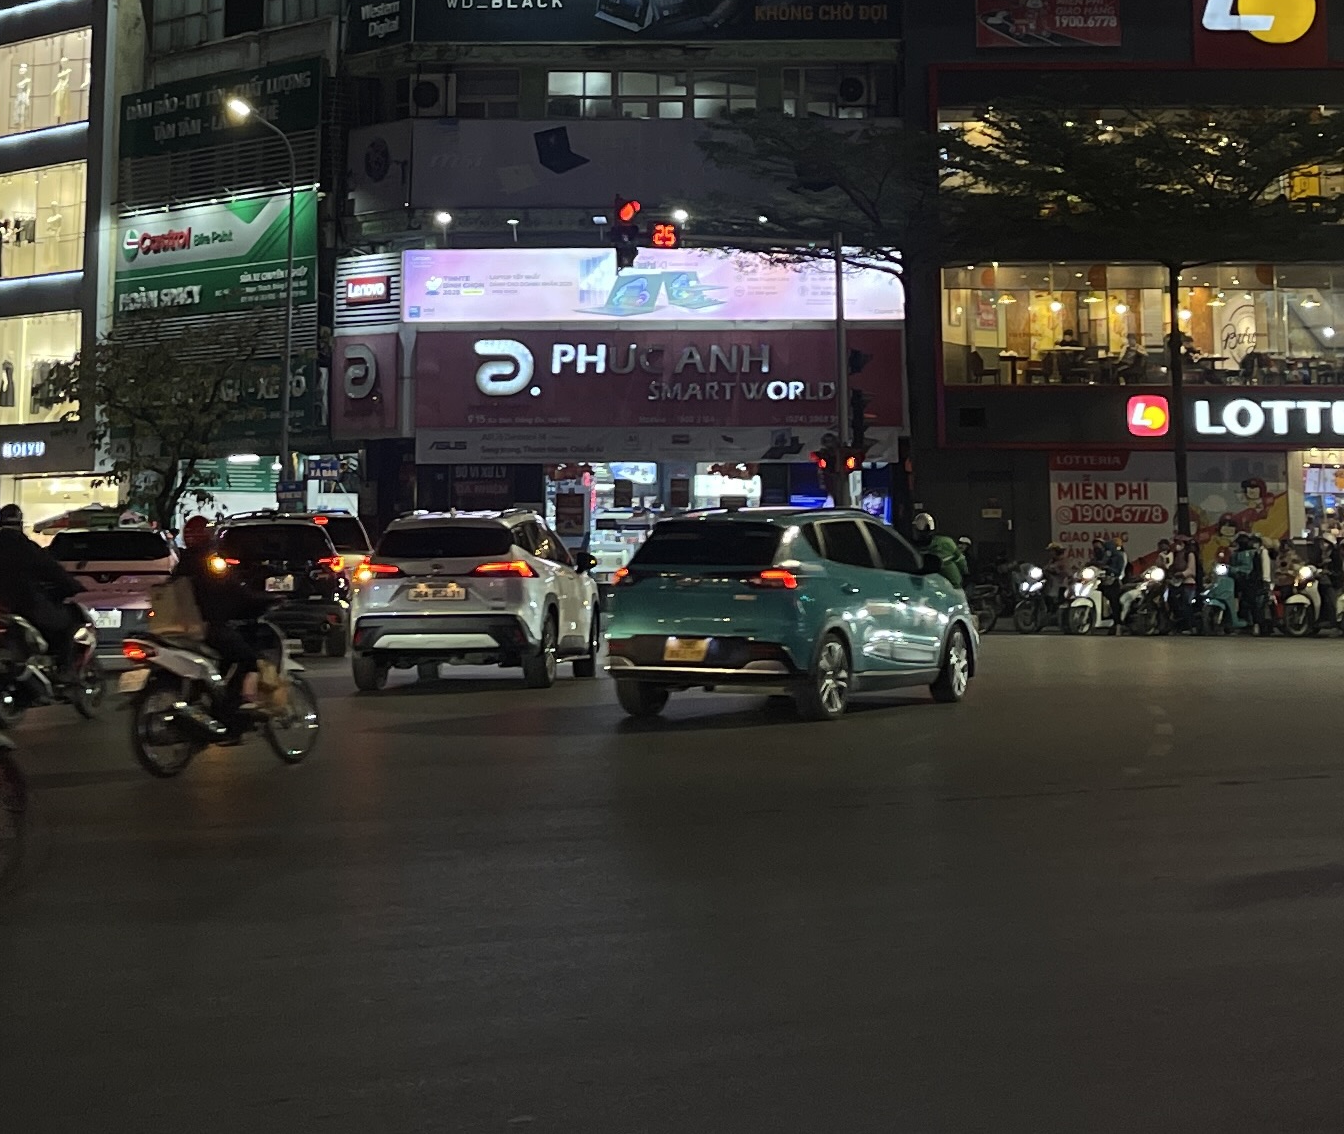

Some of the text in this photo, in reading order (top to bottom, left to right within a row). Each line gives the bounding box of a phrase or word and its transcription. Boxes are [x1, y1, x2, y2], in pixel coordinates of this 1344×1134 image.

[360, 1, 400, 20] Western
[755, 2, 887, 24] KHÔNG CHỜ ĐỢI
[368, 16, 400, 38] Digital
[653, 224, 676, 247] 25
[347, 282, 385, 298] Lenovo
[674, 343, 770, 374] ANH
[647, 380, 836, 401] SMART WORLD
[428, 440, 468, 451] ASUS
[1056, 455, 1121, 466] LOTTERIA
[1057, 474, 1149, 500] MIỄN PHÍ
[1076, 505, 1163, 523] 1900-6778
[1059, 527, 1129, 543] GIAO HÀNG
